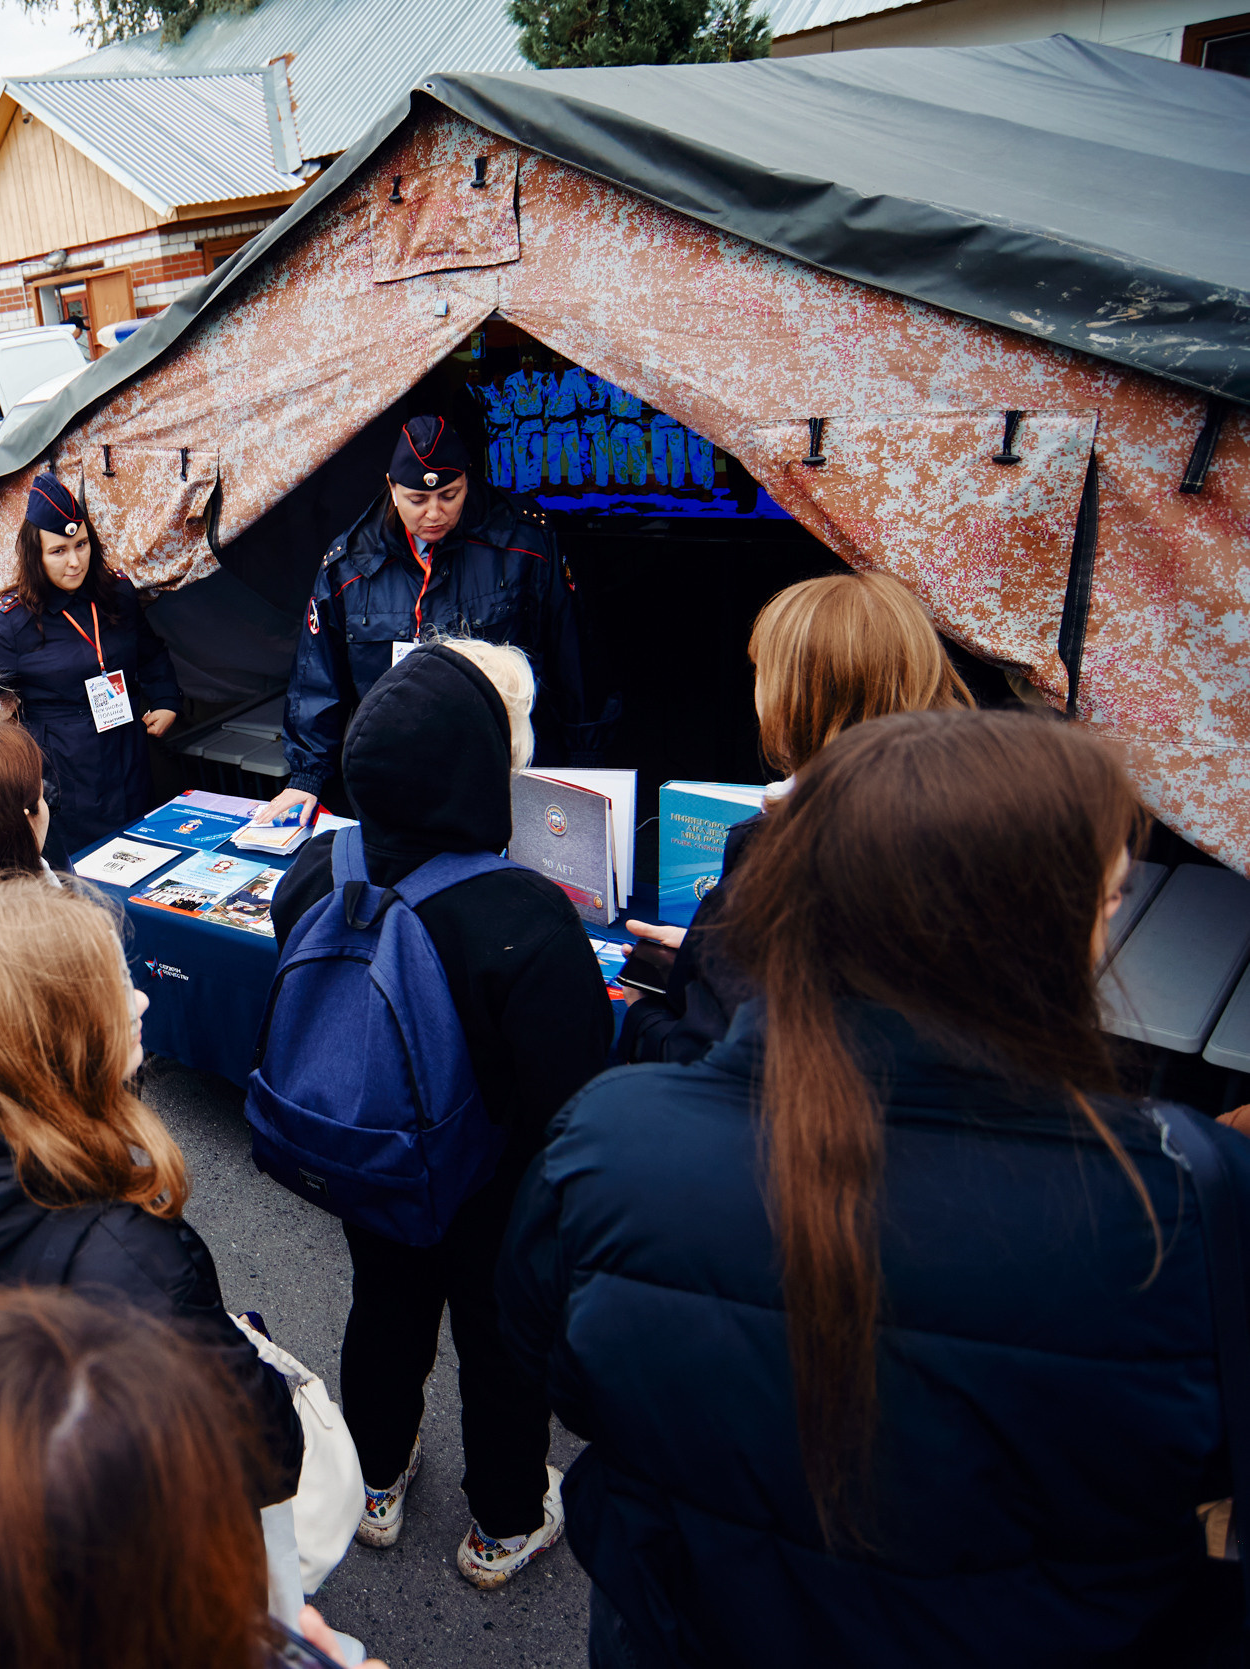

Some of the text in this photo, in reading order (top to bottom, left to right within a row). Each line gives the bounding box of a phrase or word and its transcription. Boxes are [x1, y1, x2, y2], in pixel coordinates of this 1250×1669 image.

[670, 813, 731, 830] НИЖЕГОРО
[686, 825, 729, 839] АКАДЕМ
[542, 857, 575, 875] 90 ЛЕТ
